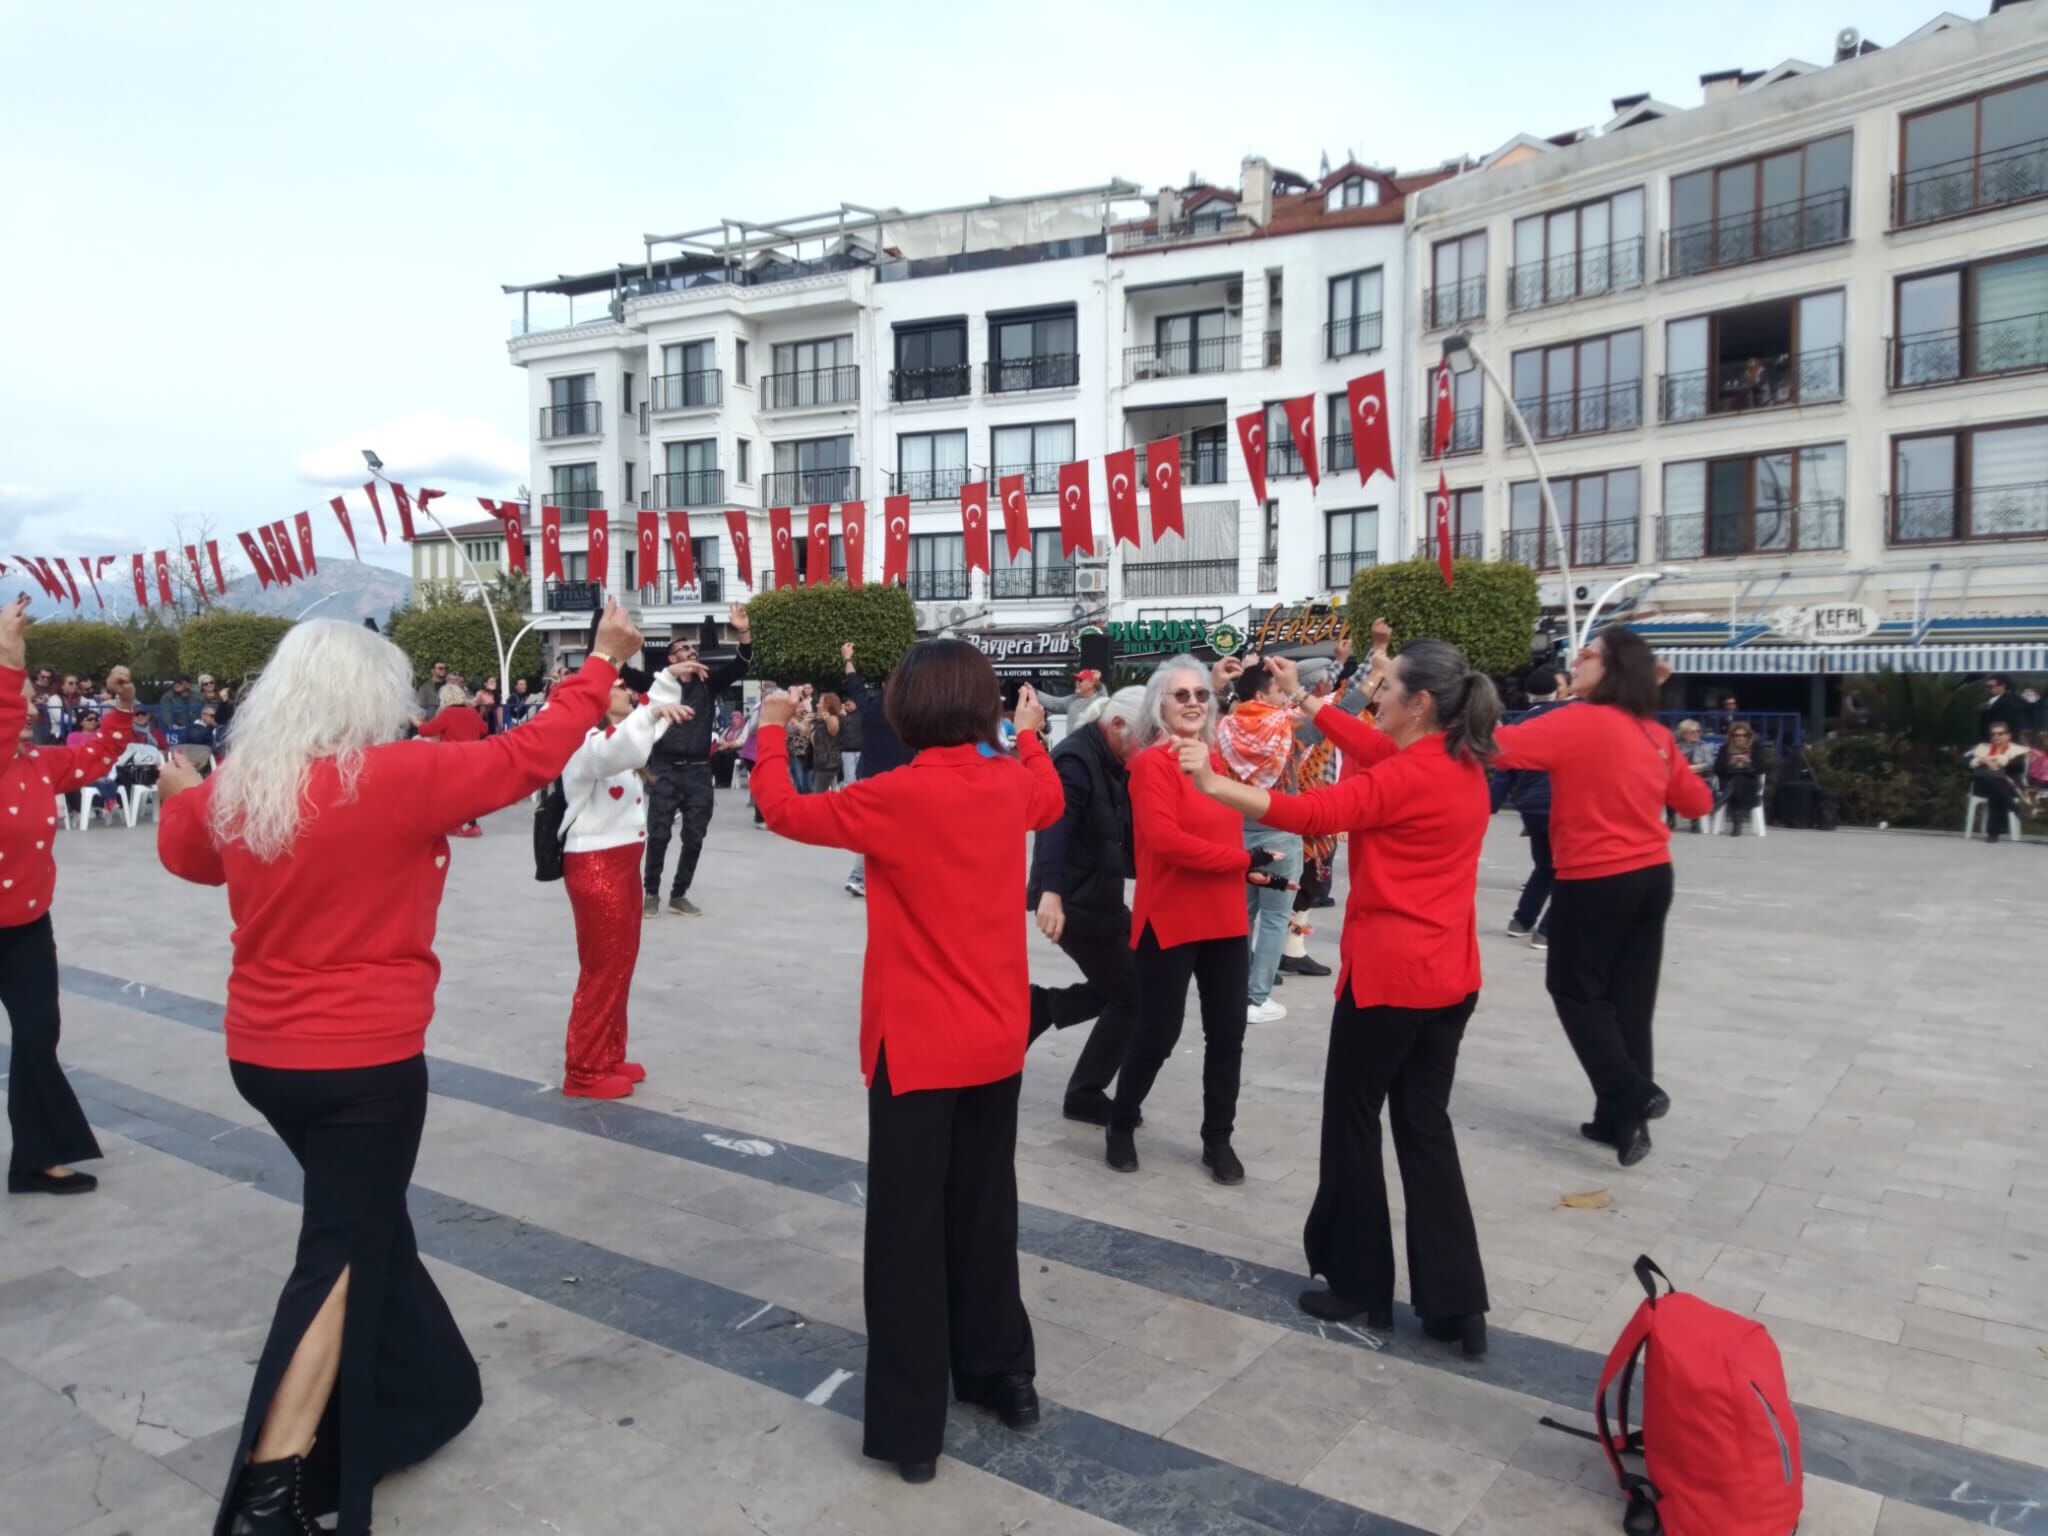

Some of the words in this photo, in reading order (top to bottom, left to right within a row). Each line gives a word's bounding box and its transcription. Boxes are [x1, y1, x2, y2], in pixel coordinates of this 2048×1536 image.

[1815, 607, 1868, 629] KEFAL
[1108, 620, 1148, 642] BIG
[1150, 619, 1207, 642] BOSS
[644, 640, 670, 648] STARBU
[1037, 631, 1070, 654] Pub
[1123, 642, 1155, 654] DRINK
[1159, 642, 1167, 654] &
[1170, 641, 1191, 653] PUB
